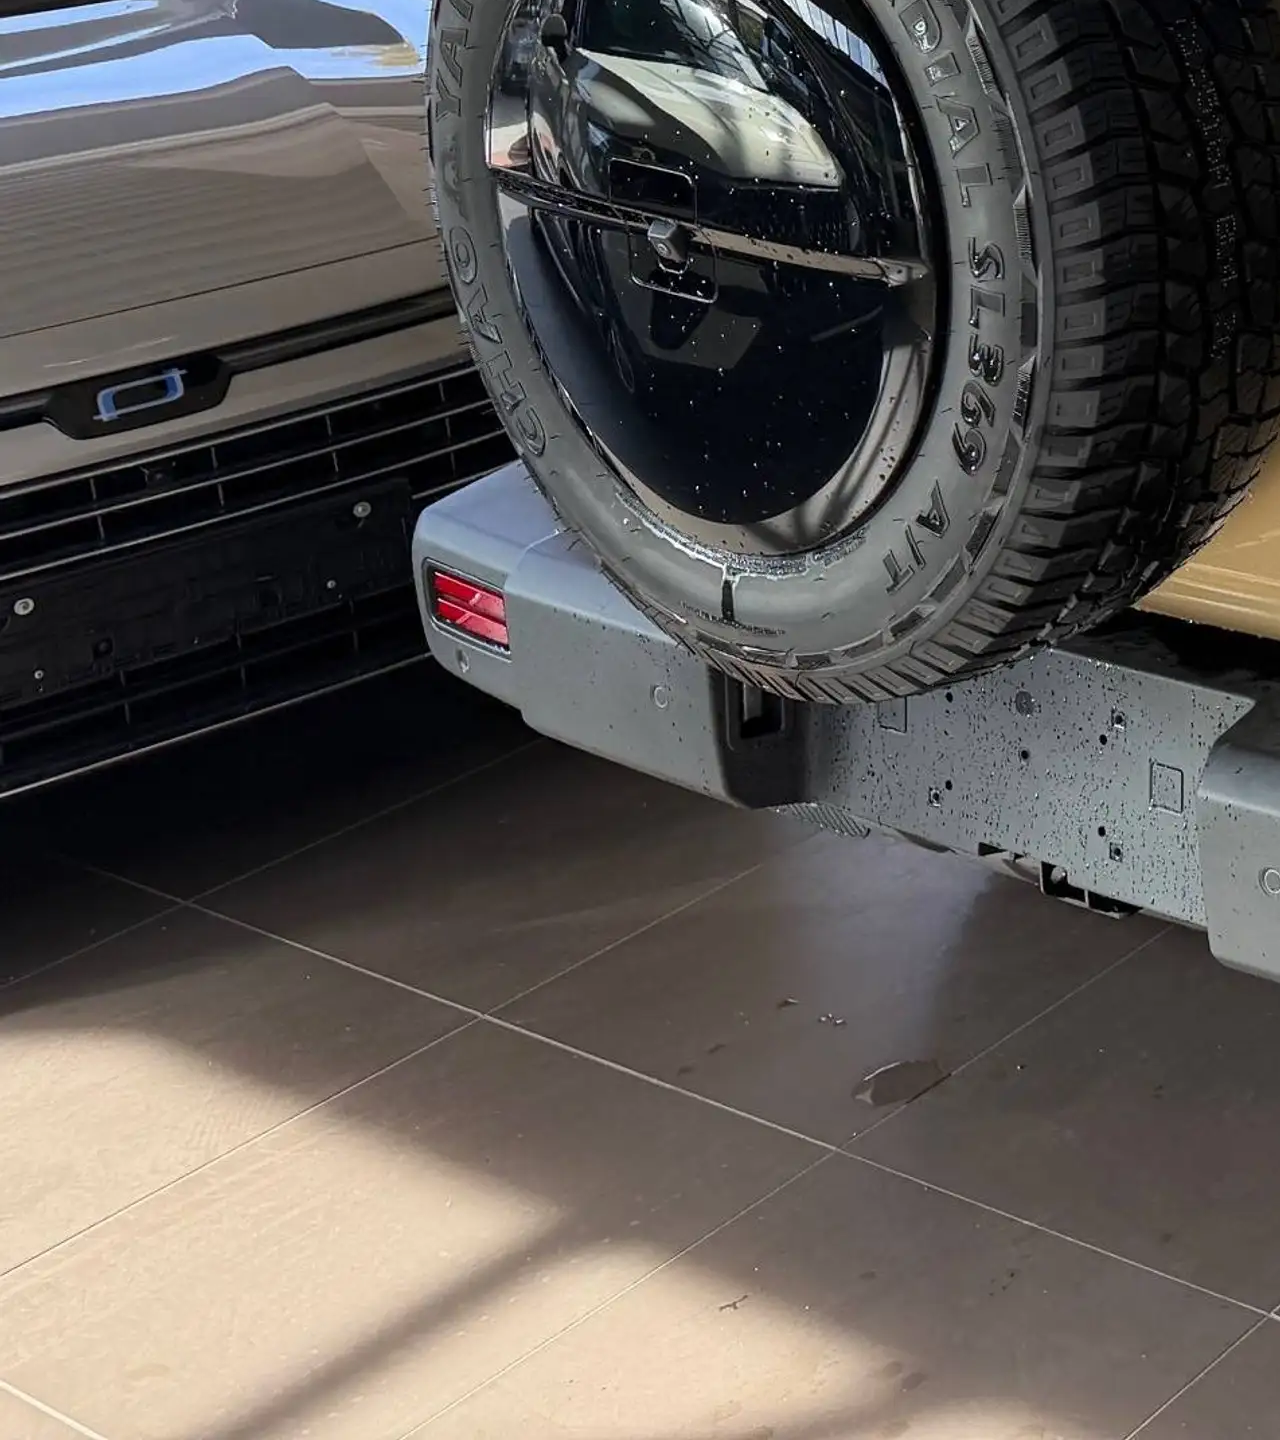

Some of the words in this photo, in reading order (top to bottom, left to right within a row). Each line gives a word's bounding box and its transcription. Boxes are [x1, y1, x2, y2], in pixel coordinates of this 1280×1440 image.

[448, 225, 546, 458] CHAO
[952, 237, 1006, 476] SL369
[882, 479, 951, 594] A/T
